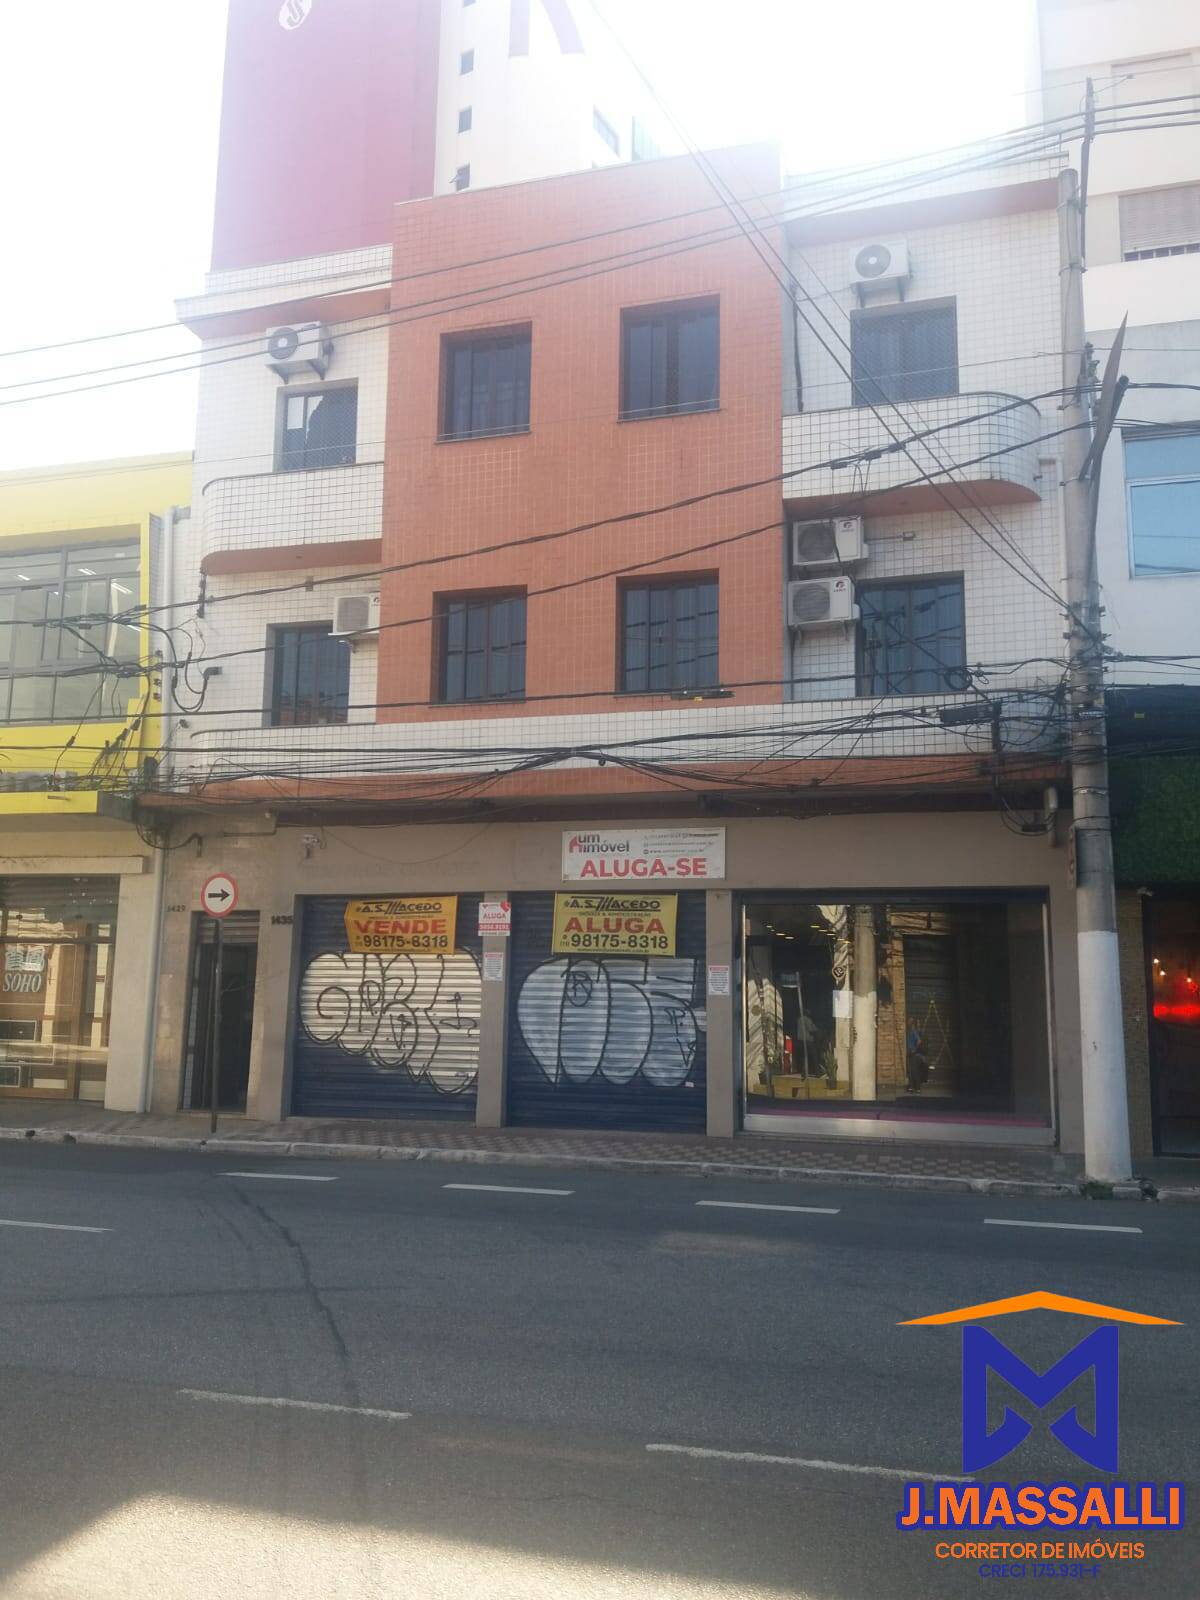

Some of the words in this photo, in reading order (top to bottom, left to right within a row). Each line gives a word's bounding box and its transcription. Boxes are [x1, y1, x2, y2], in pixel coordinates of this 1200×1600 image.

[578, 833, 600, 843] um
[580, 857, 707, 878] ALUGA-SE
[353, 918, 447, 935] VENDE
[563, 917, 665, 934] ALUGA
[363, 934, 448, 948] 98175-8318
[571, 933, 669, 949] 98175-8318
[2, 973, 42, 993] SOHO
